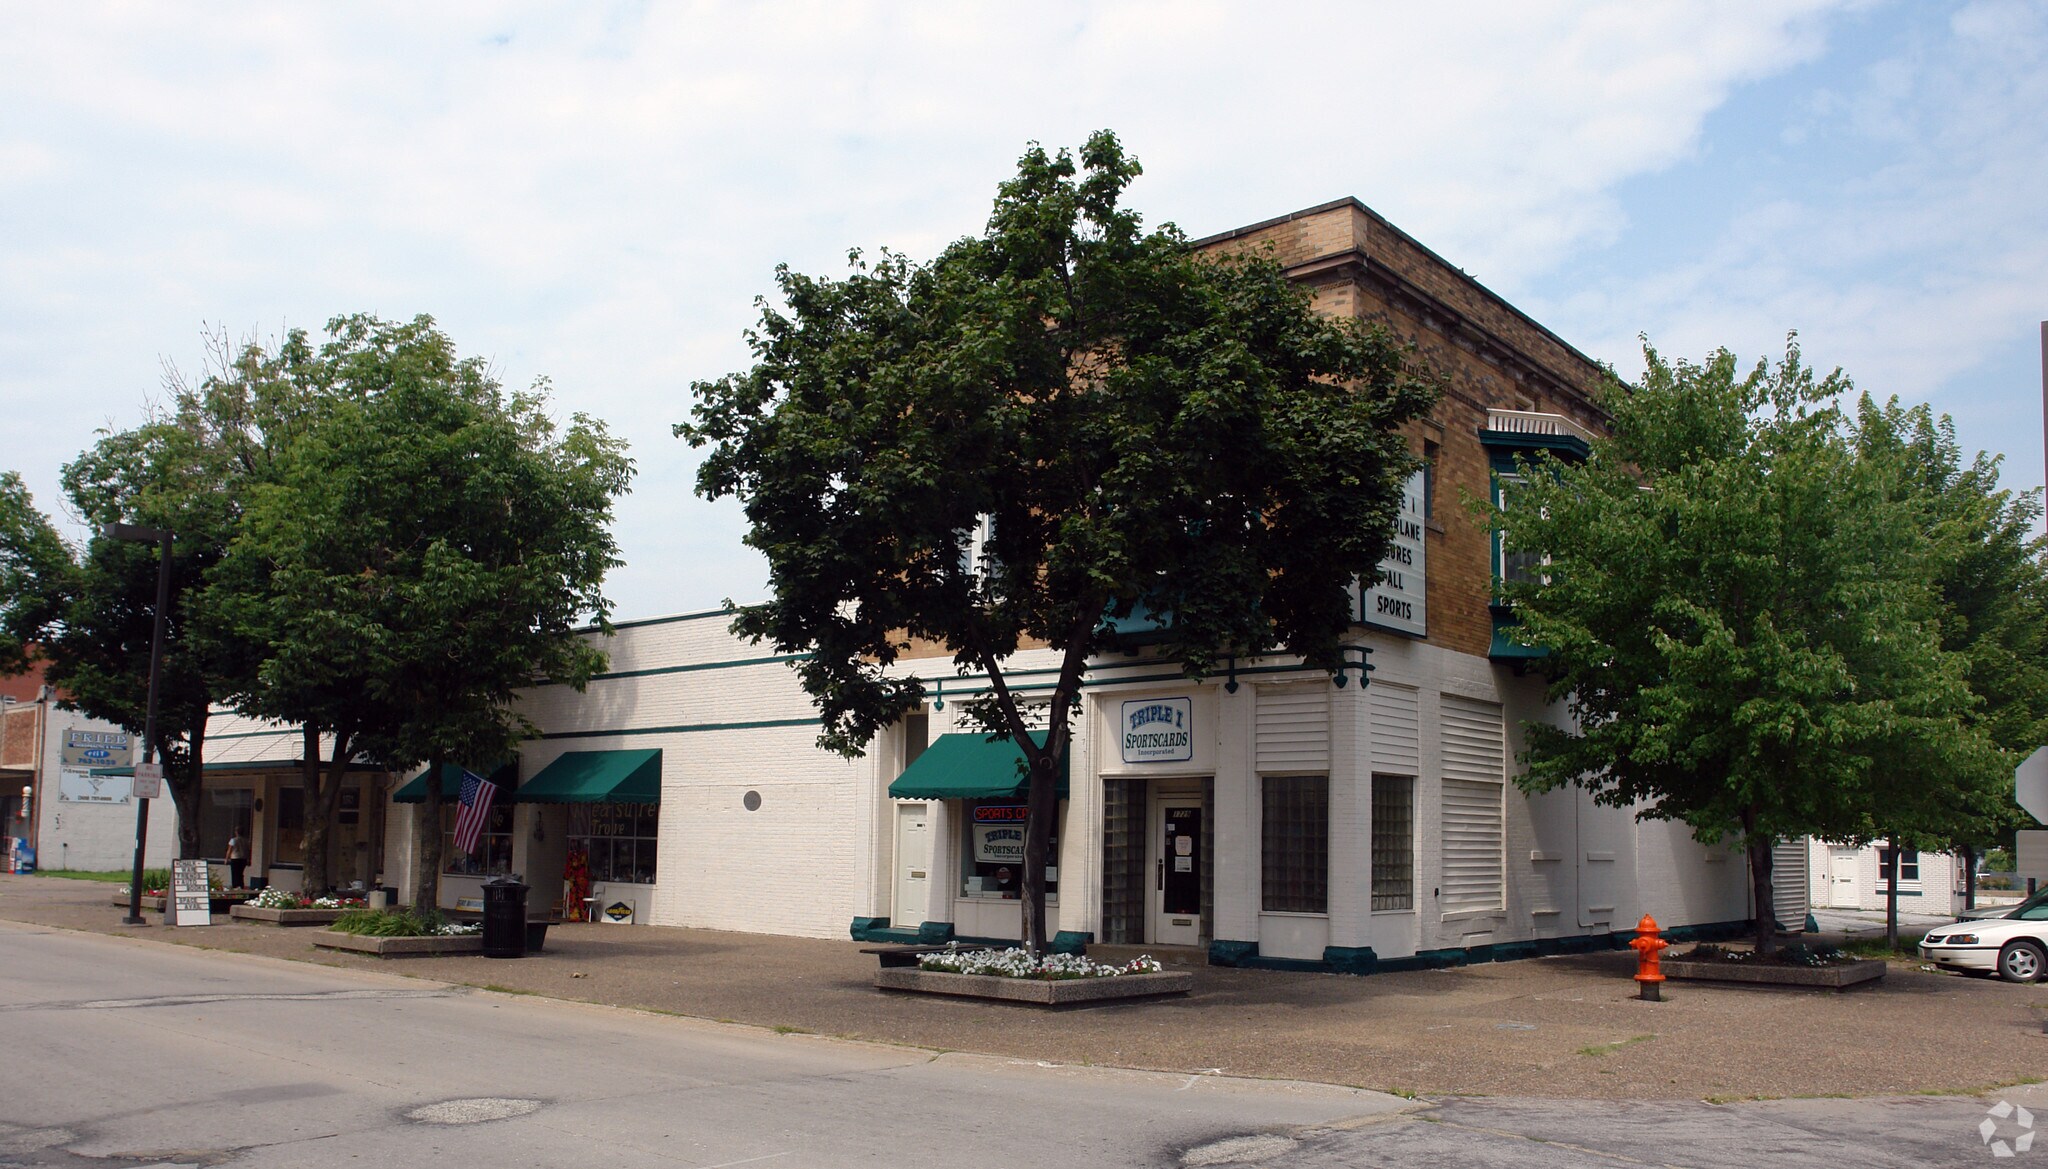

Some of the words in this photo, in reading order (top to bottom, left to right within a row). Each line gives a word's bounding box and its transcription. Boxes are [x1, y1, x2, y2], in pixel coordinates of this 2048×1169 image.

[1387, 570, 1403, 590] ALL
[1377, 595, 1412, 619] SPORTS
[1129, 704, 1173, 731] TRIPLE
[1175, 709, 1184, 730] I
[70, 732, 127, 744] FRIED
[1125, 732, 1188, 749] SPORTSCARDS
[1137, 748, 1175, 756] Incorporated
[975, 808, 1012, 819] SPORTS
[591, 819, 625, 834] Trove
[984, 829, 1022, 843] TRIPLE
